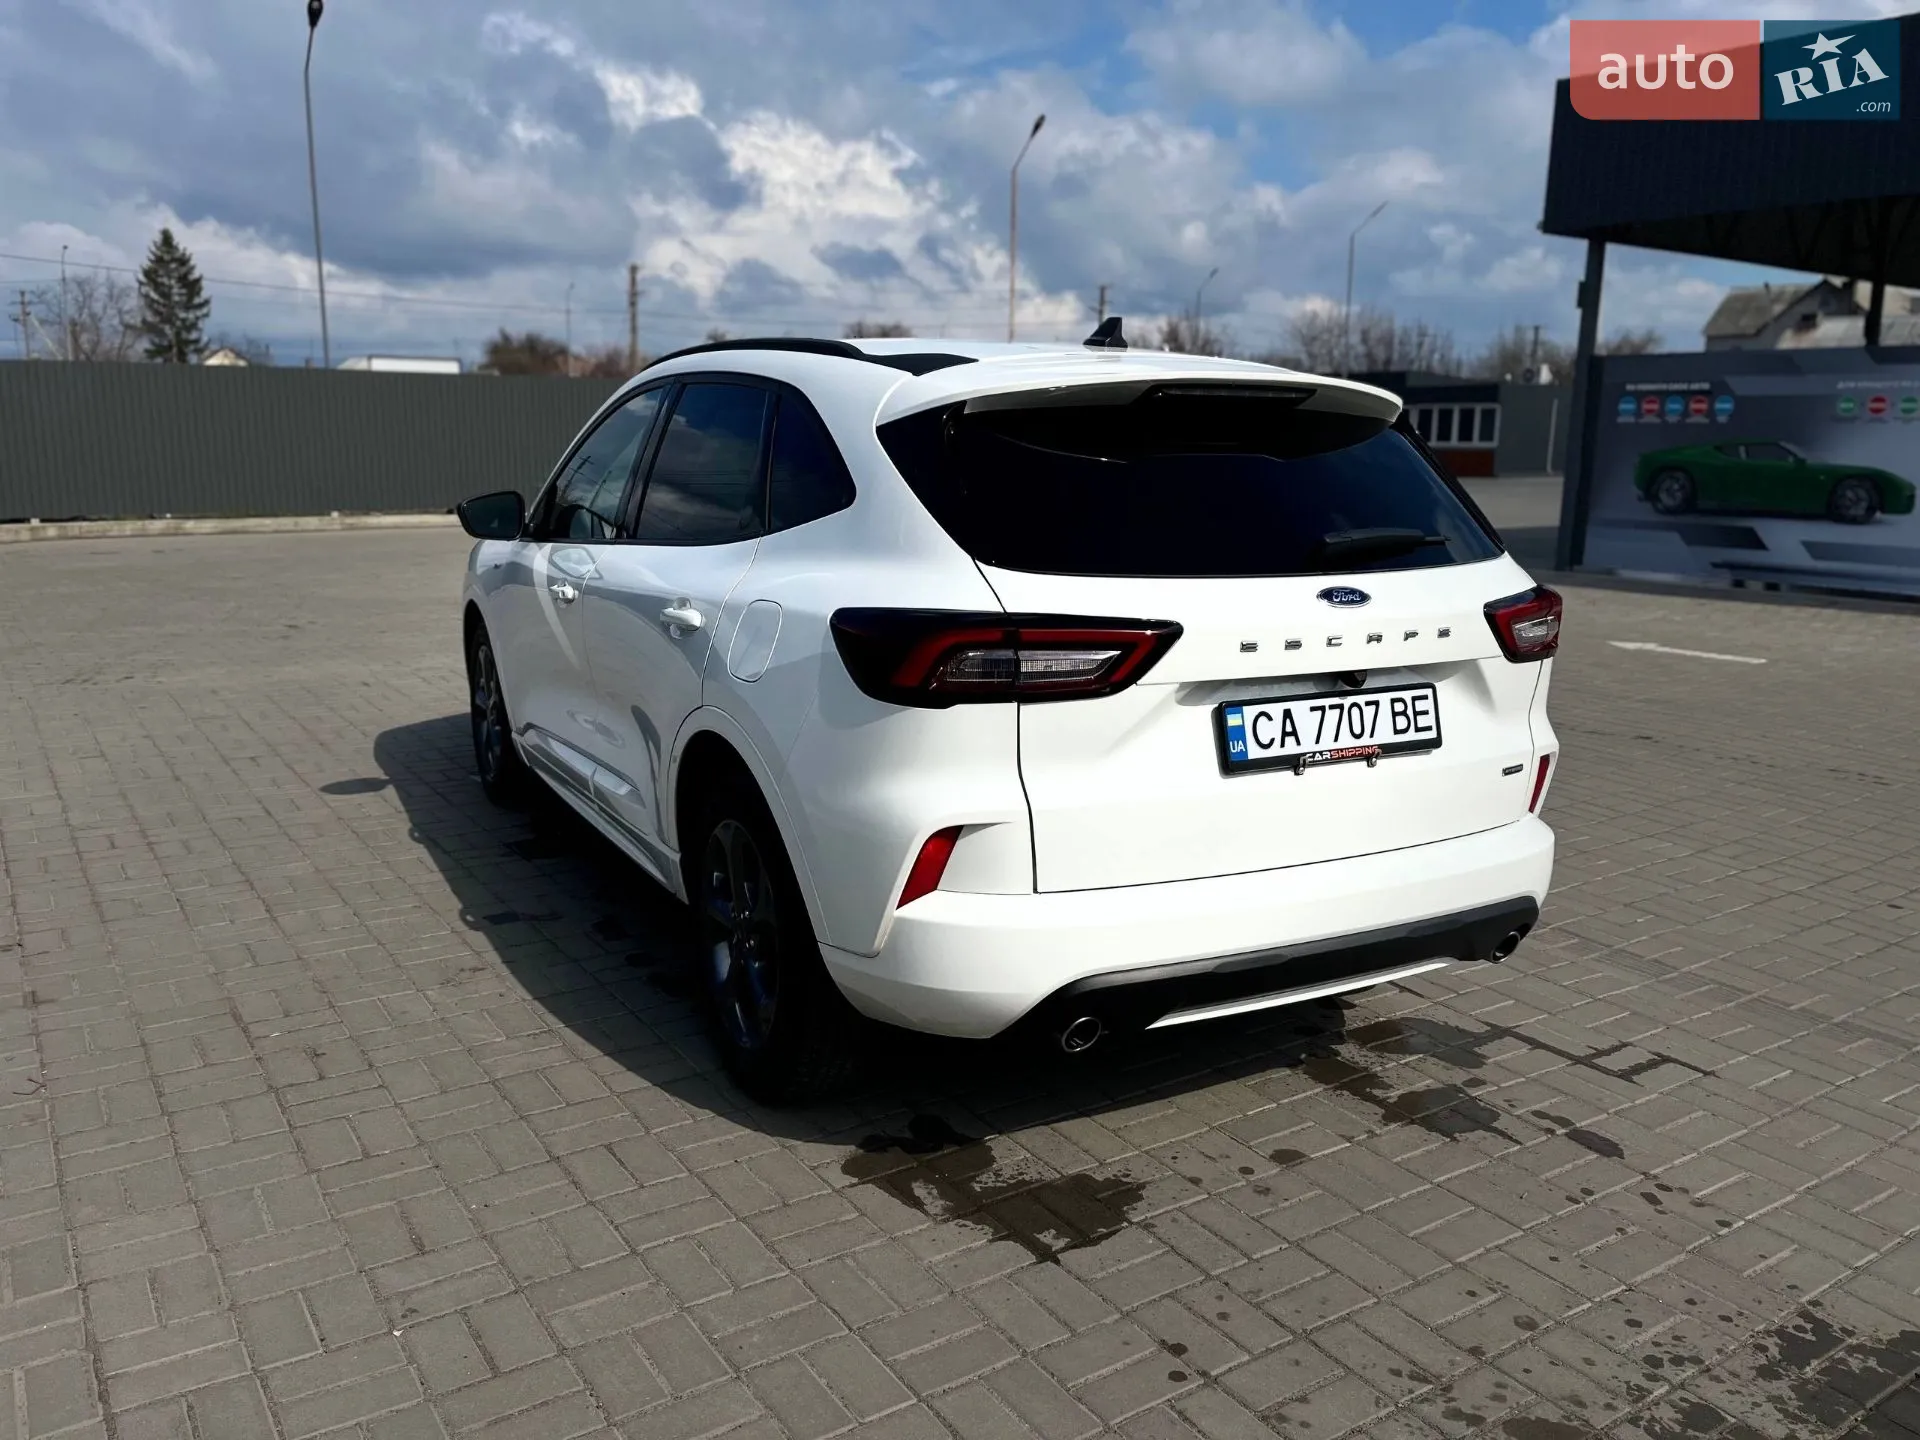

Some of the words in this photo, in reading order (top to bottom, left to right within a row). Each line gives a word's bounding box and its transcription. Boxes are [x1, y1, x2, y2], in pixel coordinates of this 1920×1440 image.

[1240, 626, 1452, 653] ESCAPE
[1252, 708, 1301, 750] CA
[1309, 700, 1380, 745] 7707
[1390, 694, 1438, 736] BE
[1229, 740, 1246, 753] UA
